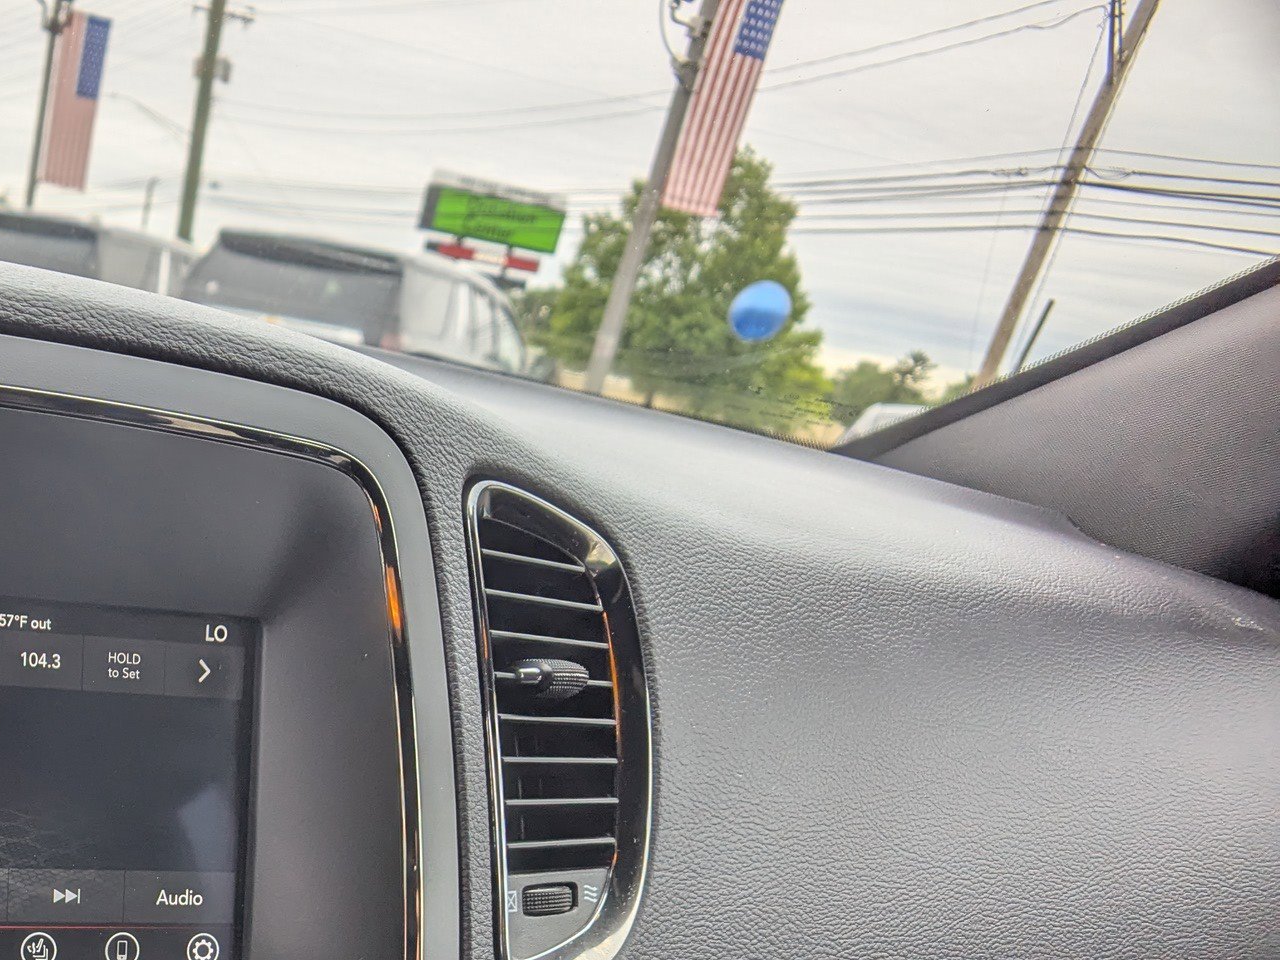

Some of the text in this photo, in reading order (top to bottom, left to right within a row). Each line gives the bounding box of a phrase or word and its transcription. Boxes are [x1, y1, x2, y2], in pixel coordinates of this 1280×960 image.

[31, 619, 51, 630] out
[206, 625, 227, 642] LO
[21, 652, 60, 668] 104.3
[108, 652, 140, 665] HOLD
[108, 668, 141, 680] to Set
[156, 889, 203, 905] Audio
